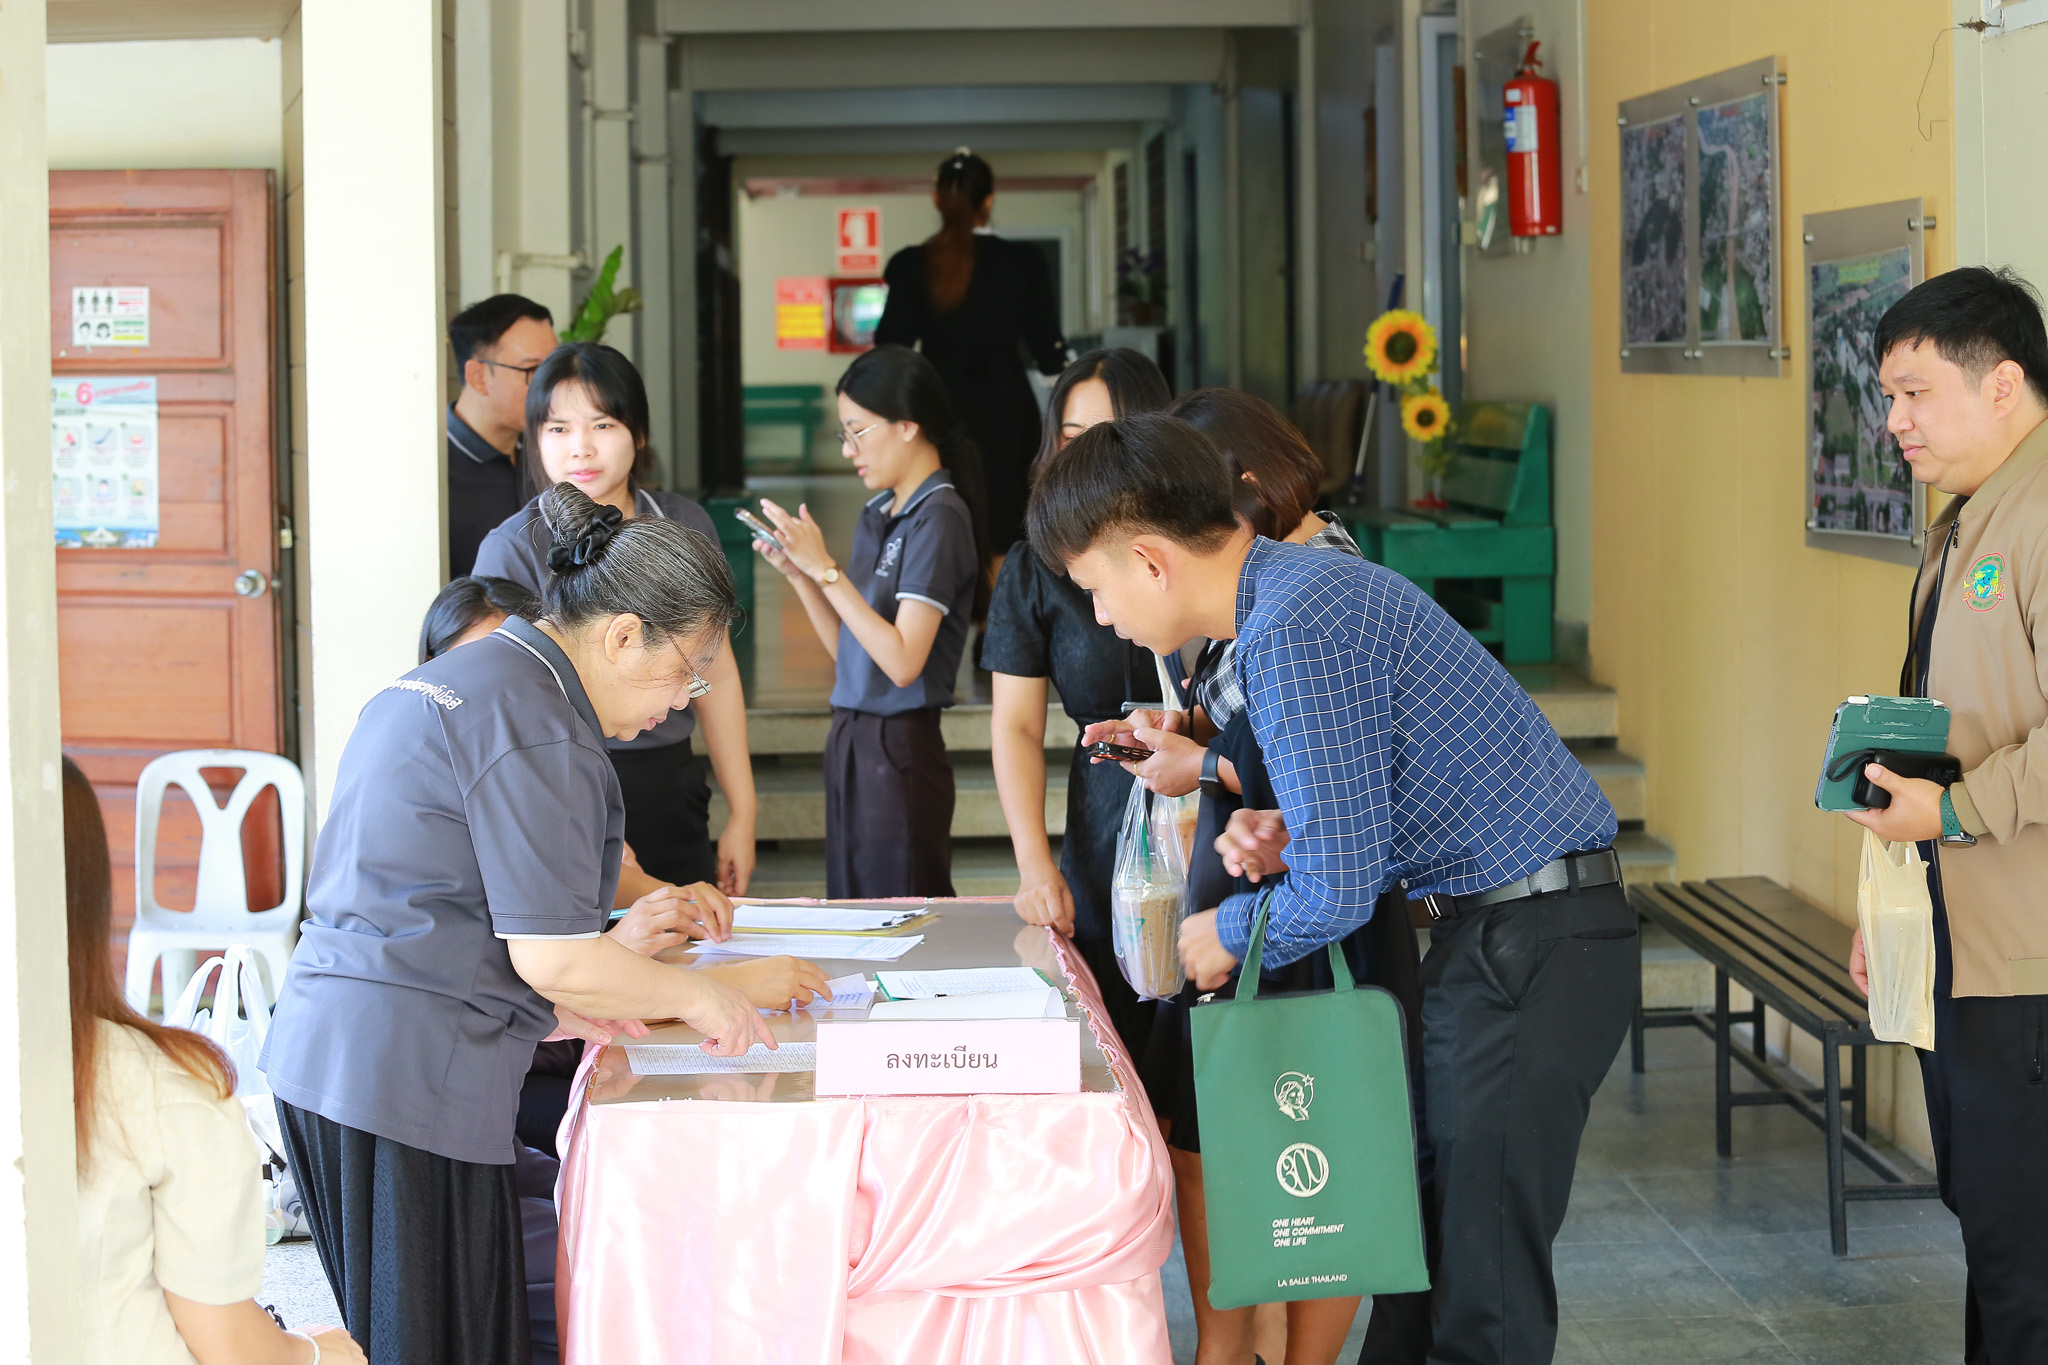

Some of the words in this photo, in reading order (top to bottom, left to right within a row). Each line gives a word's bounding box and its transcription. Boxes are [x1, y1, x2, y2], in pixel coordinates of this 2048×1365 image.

[886, 1045, 998, 1069] ลงทะเบียน
[1272, 1218, 1289, 1228] ONE
[1290, 1216, 1315, 1227] HEART
[1273, 1228, 1290, 1238] ONE
[1292, 1223, 1344, 1236] COMMITMENT
[1273, 1238, 1290, 1248] ONE
[1292, 1236, 1307, 1246] LIFE
[1277, 1279, 1288, 1288] LA
[1289, 1276, 1310, 1287] SALLE
[1311, 1273, 1348, 1284] THAILAND
